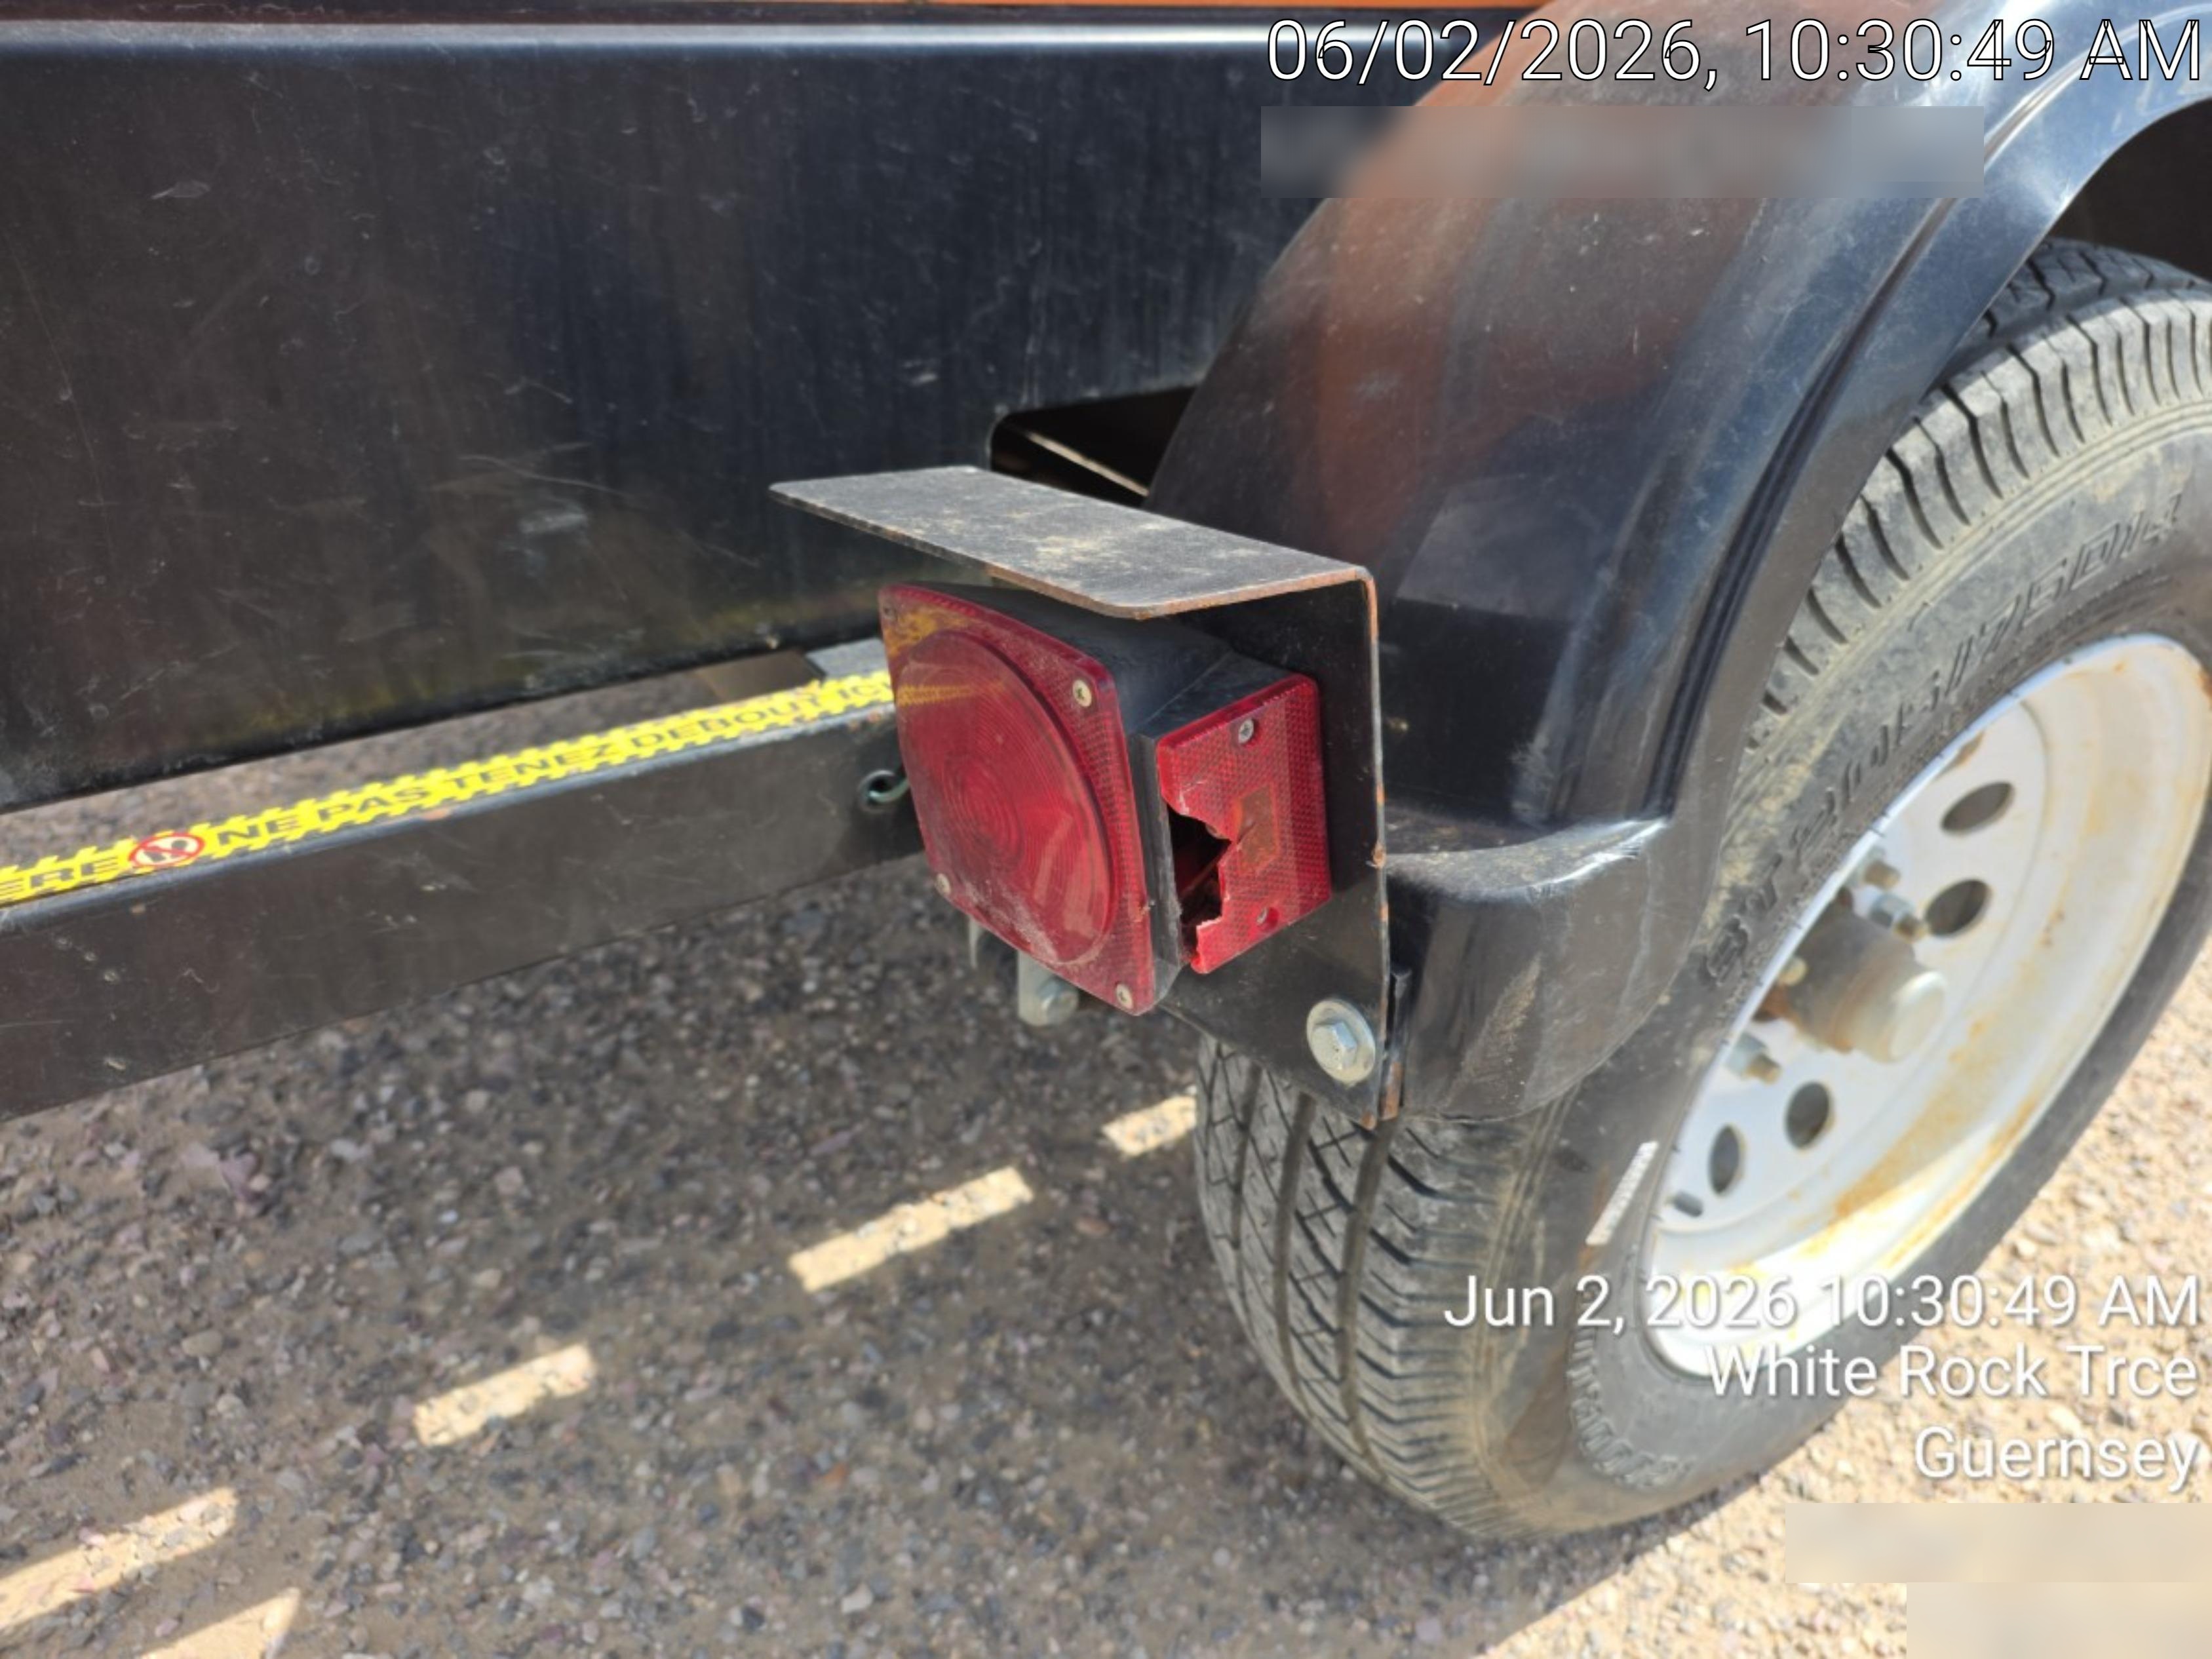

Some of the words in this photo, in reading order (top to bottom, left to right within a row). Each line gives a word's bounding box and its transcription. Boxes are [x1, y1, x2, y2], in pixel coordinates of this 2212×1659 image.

[216, 813, 300, 847] NE
[317, 785, 431, 819] PAS
[443, 743, 613, 789] TENEZ
[630, 691, 821, 748] DEBOUT
